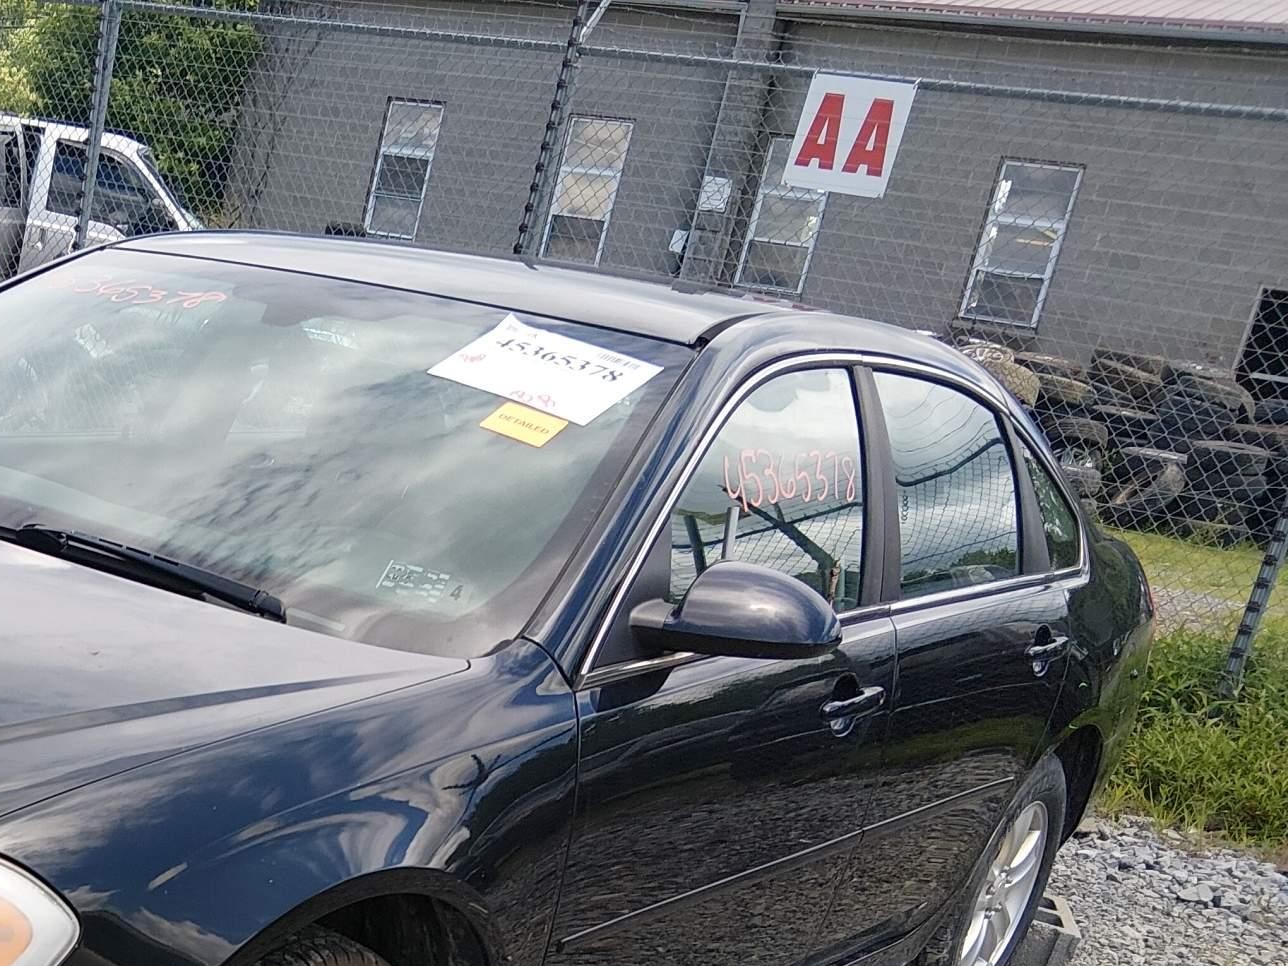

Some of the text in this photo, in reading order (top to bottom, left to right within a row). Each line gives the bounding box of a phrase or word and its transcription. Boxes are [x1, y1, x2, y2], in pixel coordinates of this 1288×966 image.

[794, 92, 895, 177] AA
[495, 338, 624, 382] 45365378
[723, 449, 856, 512] 45365378
